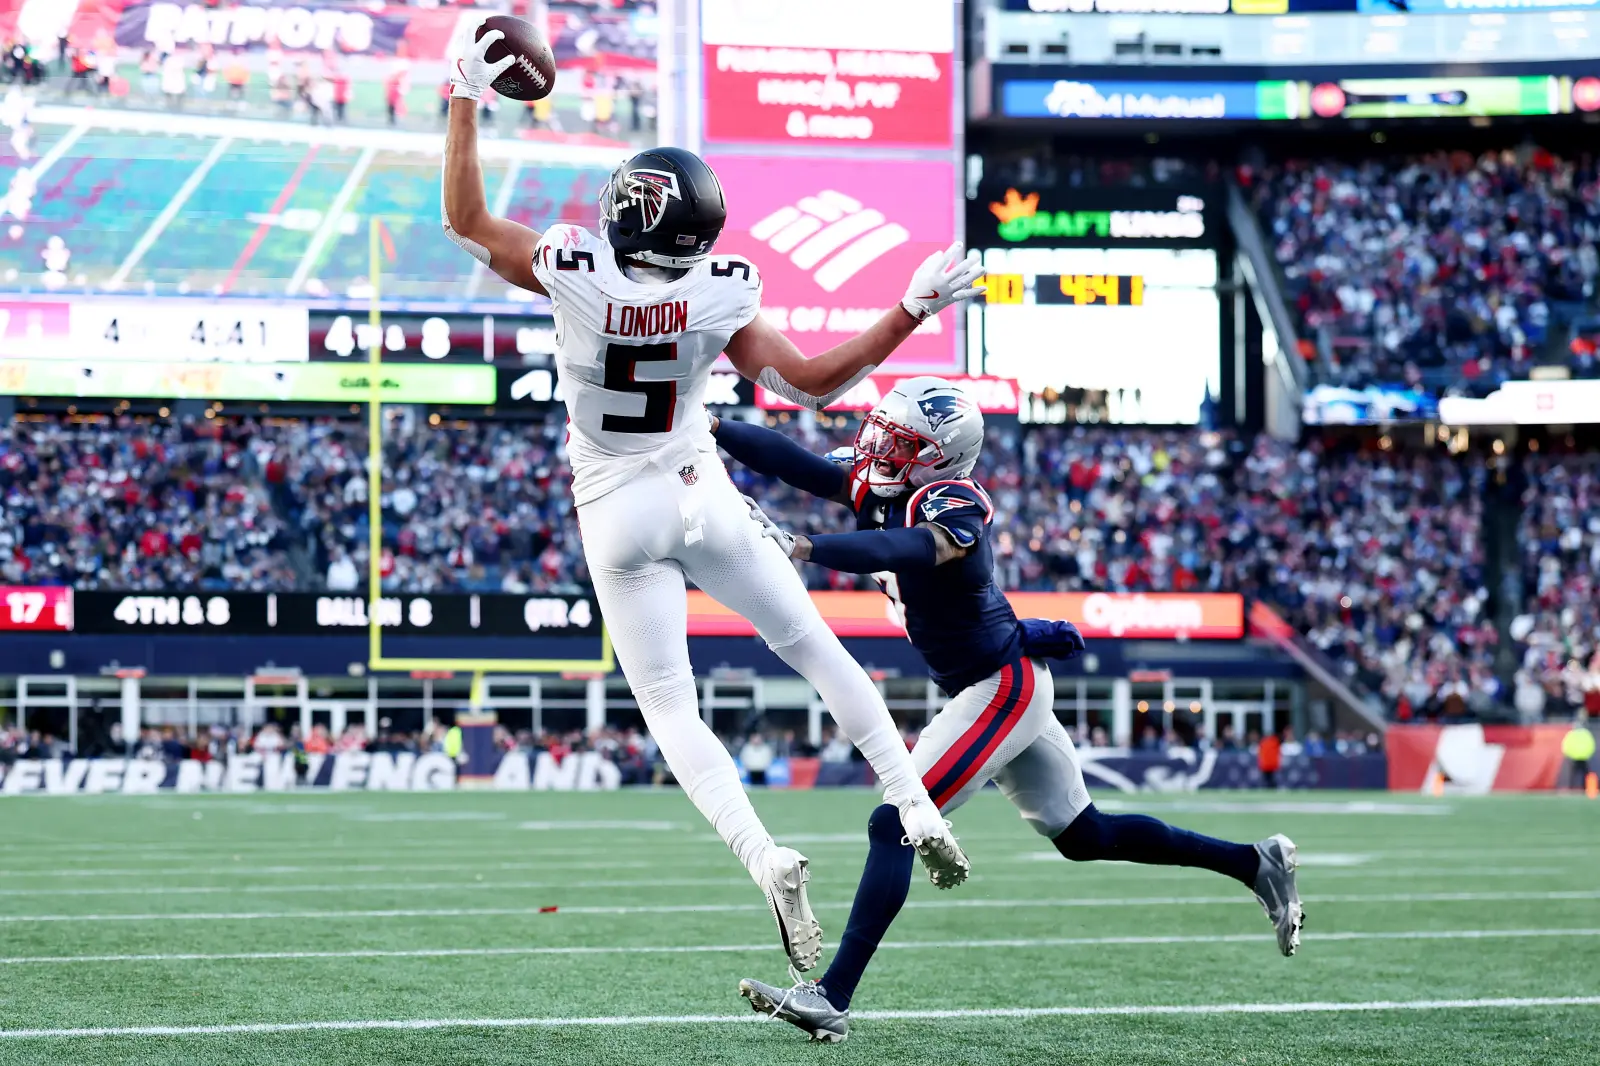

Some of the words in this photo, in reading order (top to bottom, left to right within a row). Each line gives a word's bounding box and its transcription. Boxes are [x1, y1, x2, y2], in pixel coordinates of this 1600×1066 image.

[1124, 93, 1225, 119] Mutual
[556, 249, 596, 273] 5
[711, 261, 750, 281] 5
[1059, 273, 1144, 306] 4:41
[605, 301, 688, 337] LONDON
[826, 308, 943, 335] AMEA
[190, 319, 267, 347] 4:41
[421, 317, 451, 360] 8
[601, 342, 677, 433] 5
[6, 591, 46, 624] 17
[114, 595, 180, 625] 4TH
[182, 596, 204, 626] &
[206, 596, 231, 626] 8
[316, 597, 369, 627] BALL
[408, 598, 433, 627] 8
[568, 599, 592, 628] 4
[1082, 592, 1203, 637] Optum
[0, 758, 167, 794] EVER
[176, 753, 328, 794] NEW
[329, 751, 621, 794] ENGAND
